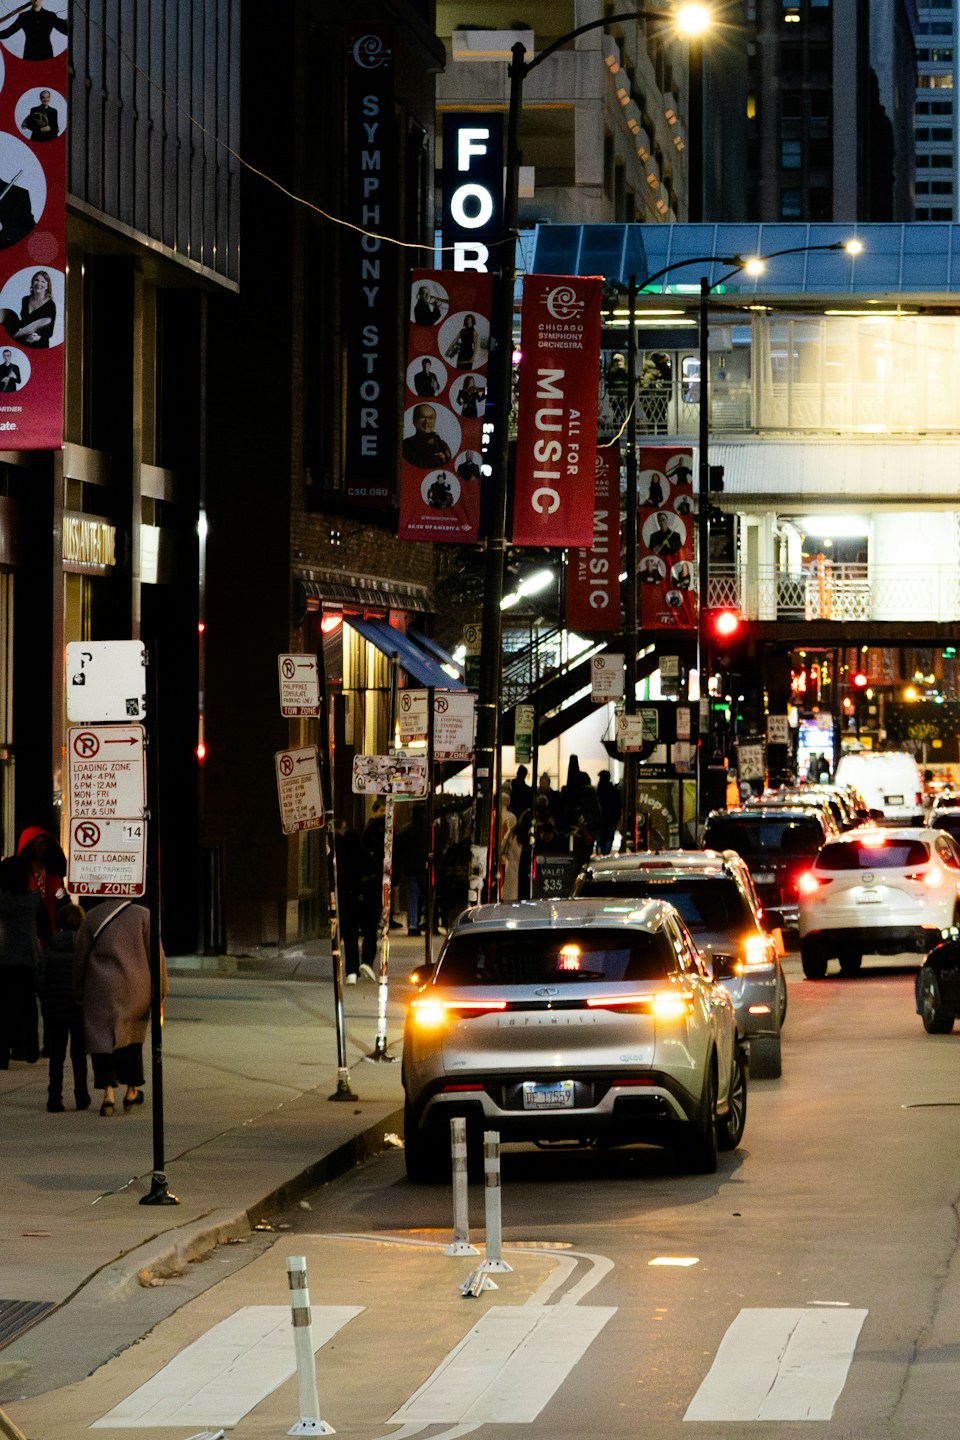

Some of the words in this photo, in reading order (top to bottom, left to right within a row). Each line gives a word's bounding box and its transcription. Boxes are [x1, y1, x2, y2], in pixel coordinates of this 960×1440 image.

[361, 95, 381, 307] SYMPHONY
[538, 323, 584, 331] CHICAGO
[538, 332, 583, 340] SYMPHONY
[538, 341, 583, 349] ORCHESTRA
[360, 325, 380, 456] STORE
[568, 408, 581, 436] ALL
[531, 368, 565, 514] MUSIC
[566, 443, 580, 475] FOR
[589, 510, 609, 609] MUSIC
[284, 707, 298, 715] TOW
[300, 707, 317, 715] ZONE
[73, 763, 108, 772] LOADING
[110, 762, 131, 771] ZONE
[74, 808, 90, 817] SAT
[91, 808, 98, 816] &
[99, 808, 116, 816] SUN
[73, 854, 98, 862] VALET
[102, 854, 136, 863] LOADING
[72, 882, 102, 894] TOW
[104, 883, 137, 894] ZONE
[543, 879, 563, 891] $35
